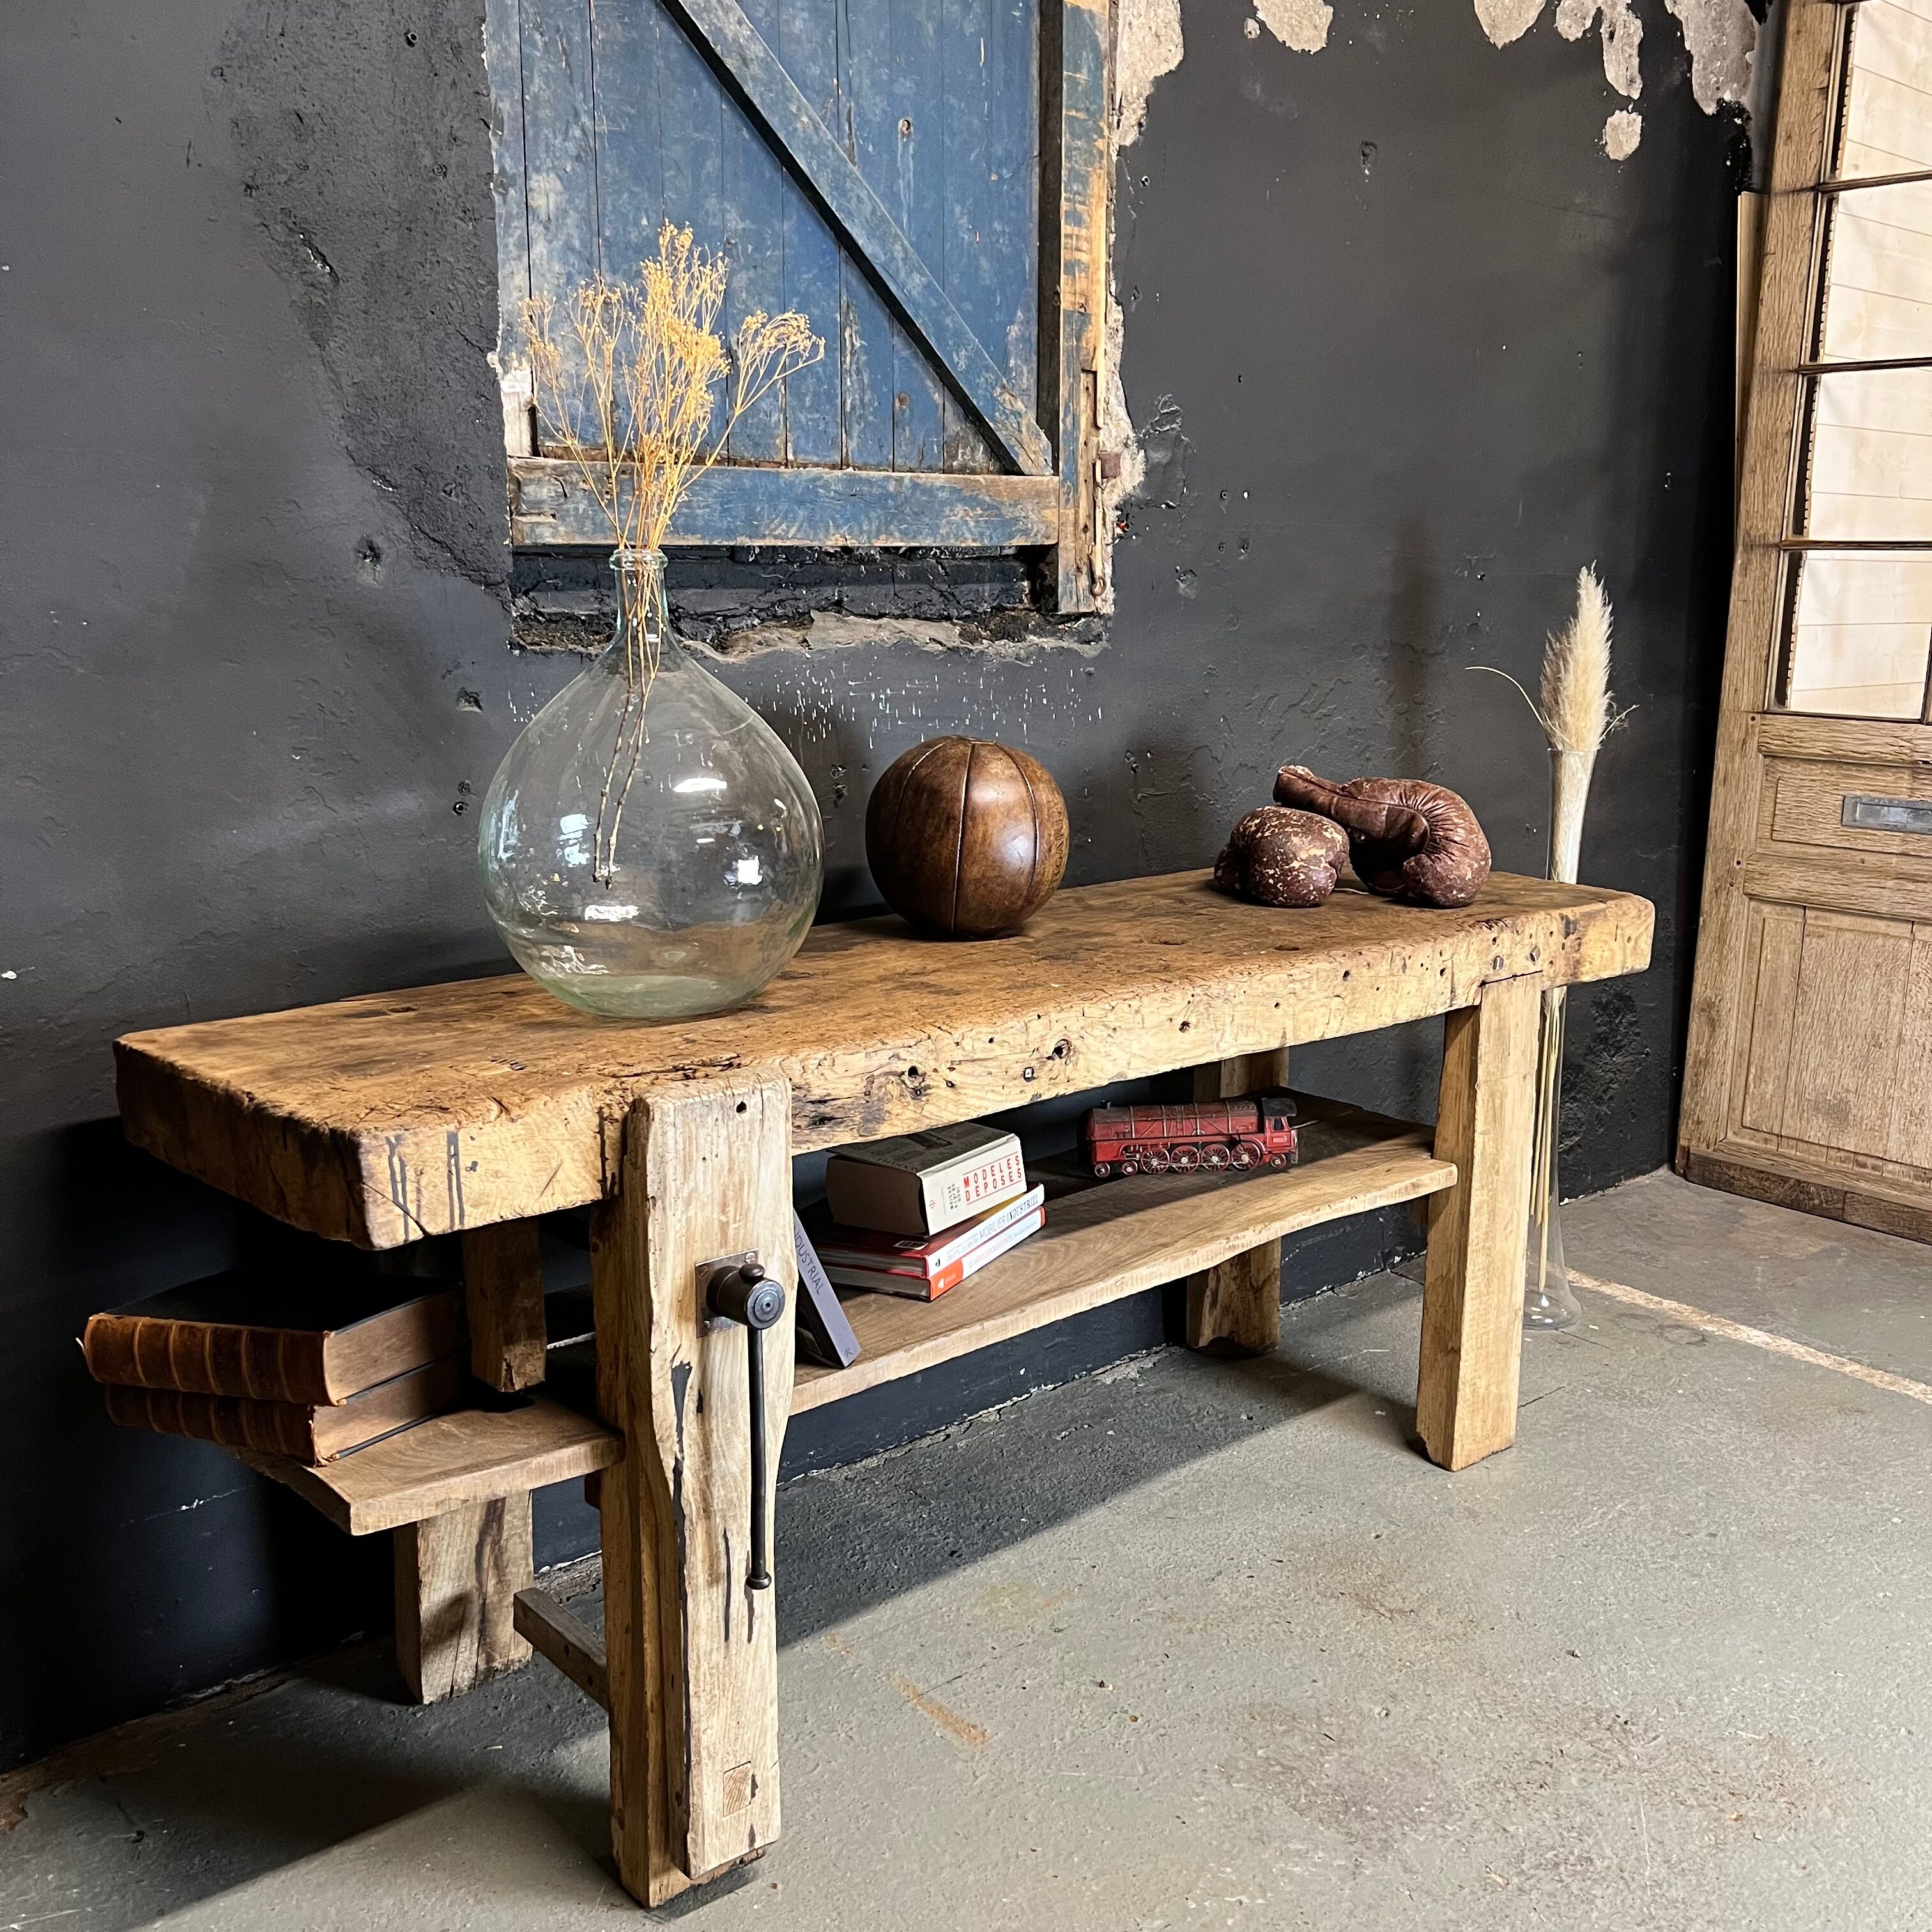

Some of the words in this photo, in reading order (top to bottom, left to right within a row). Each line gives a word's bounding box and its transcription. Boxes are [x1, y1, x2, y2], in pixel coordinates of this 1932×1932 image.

[963, 1155, 1020, 1188] MODELES
[965, 1168, 1022, 1202] DEPOSES
[794, 1225, 824, 1296] DUSTRIAL
